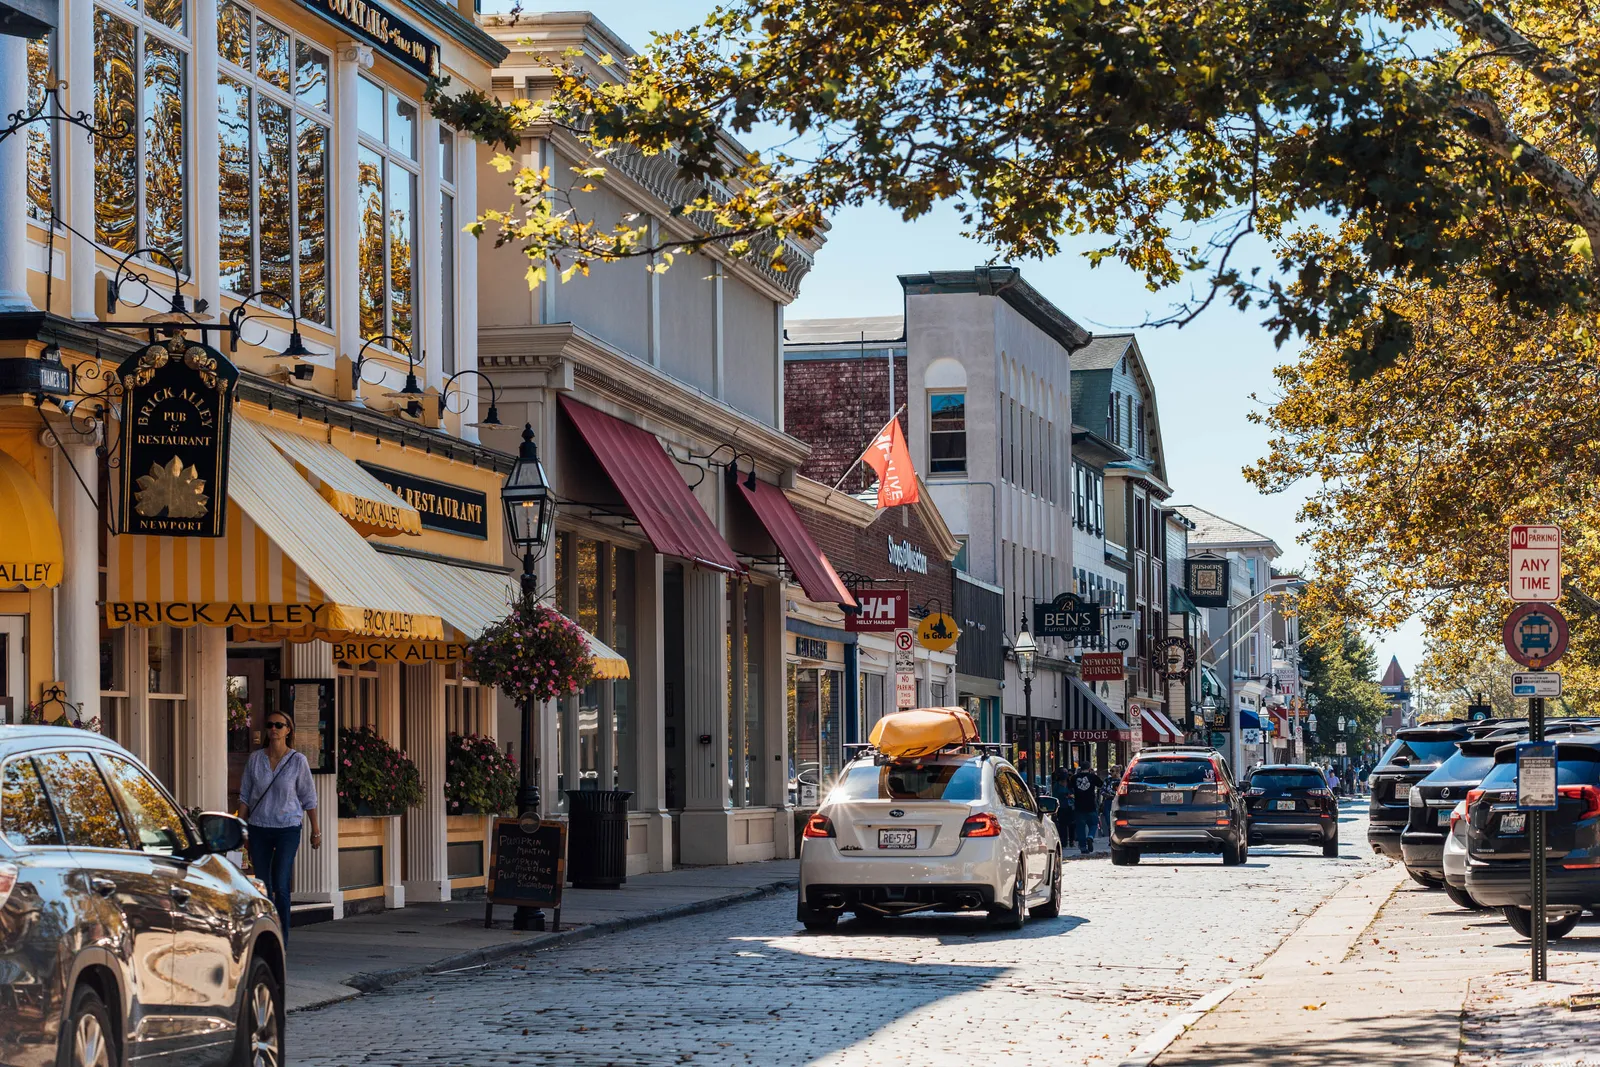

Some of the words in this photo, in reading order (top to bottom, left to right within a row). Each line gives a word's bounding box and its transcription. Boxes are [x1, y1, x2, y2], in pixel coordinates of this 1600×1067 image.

[41, 369, 60, 387] THAMES
[61, 373, 69, 389] ST.
[138, 387, 175, 426] BRICK
[179, 388, 214, 429] ALLEY
[163, 411, 187, 422] PUB
[170, 424, 179, 433] &
[138, 435, 212, 447] RESTAURANT
[354, 498, 378, 520] BRICK
[378, 503, 401, 524] ALLEY
[405, 488, 483, 525] RESTAURANT
[140, 520, 204, 531] NEWPORT
[1512, 531, 1526, 545] NO
[1528, 534, 1557, 542] PARKING
[0, 563, 51, 582] ALLEY
[1520, 559, 1550, 572] ANY
[1520, 577, 1551, 590] TIME
[114, 602, 215, 623] BRICK
[224, 604, 325, 624] ALLEY
[1044, 612, 1091, 626] BEN'S
[363, 609, 387, 631] BRICK
[389, 612, 413, 633] ALLEY
[333, 643, 397, 660] BRICK
[405, 642, 471, 660] ALLEY
[1084, 667, 1122, 675] FUDGERY
[901, 675, 909, 683] NO
[1072, 731, 1108, 739] FUDGE
